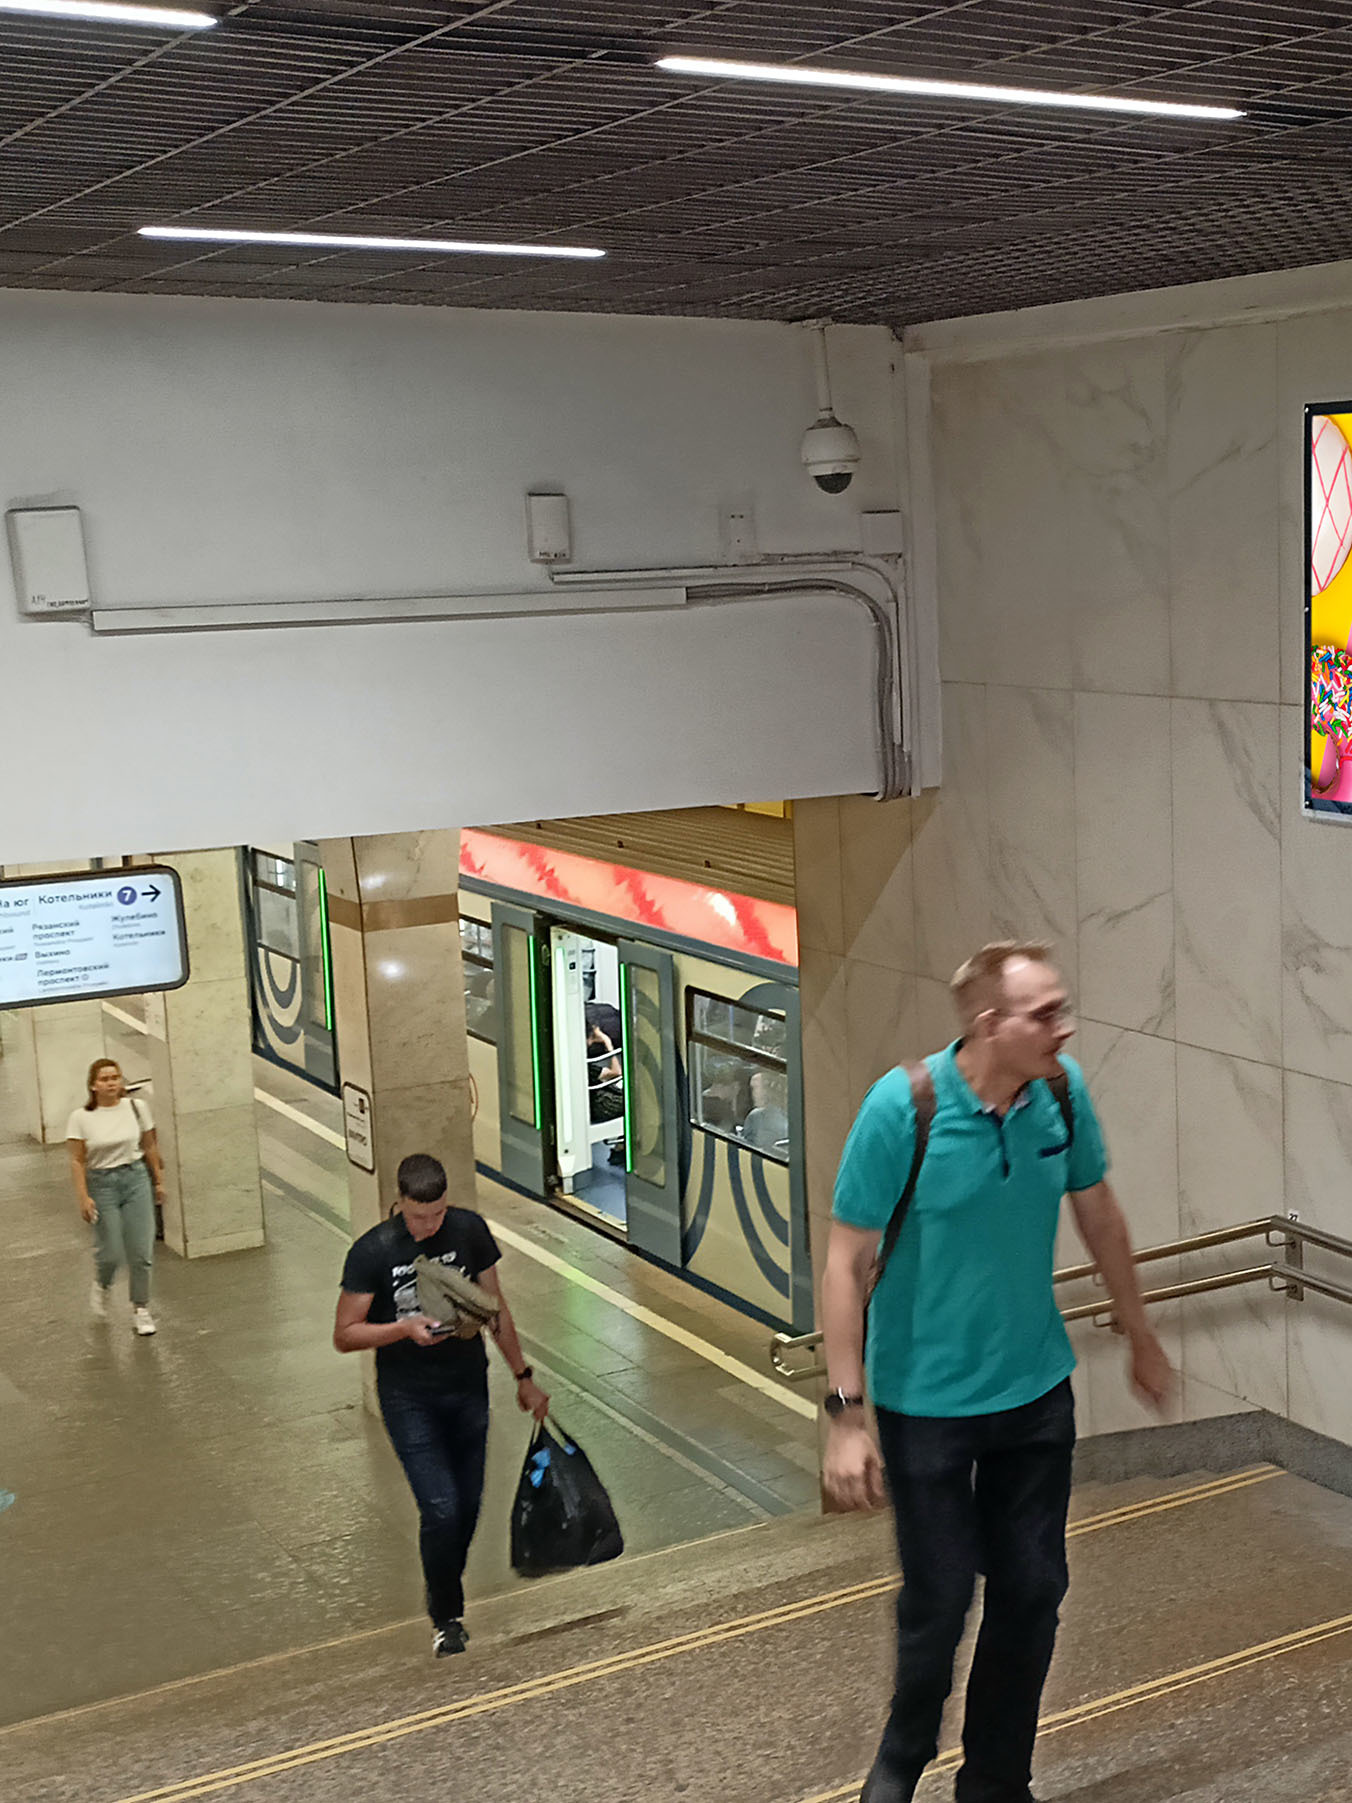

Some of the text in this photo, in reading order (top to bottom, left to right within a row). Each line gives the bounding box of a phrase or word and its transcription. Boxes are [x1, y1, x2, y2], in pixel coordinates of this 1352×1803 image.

[14, 898, 29, 907] юг
[38, 891, 112, 904] Котельники
[111, 912, 158, 922] Жулебино
[32, 920, 80, 931] Рязанский
[33, 929, 75, 940] проспект
[113, 931, 166, 941] Котельники
[34, 949, 71, 959] Выхино
[37, 963, 110, 977] Лермонтовский
[38, 976, 80, 987] проспект
